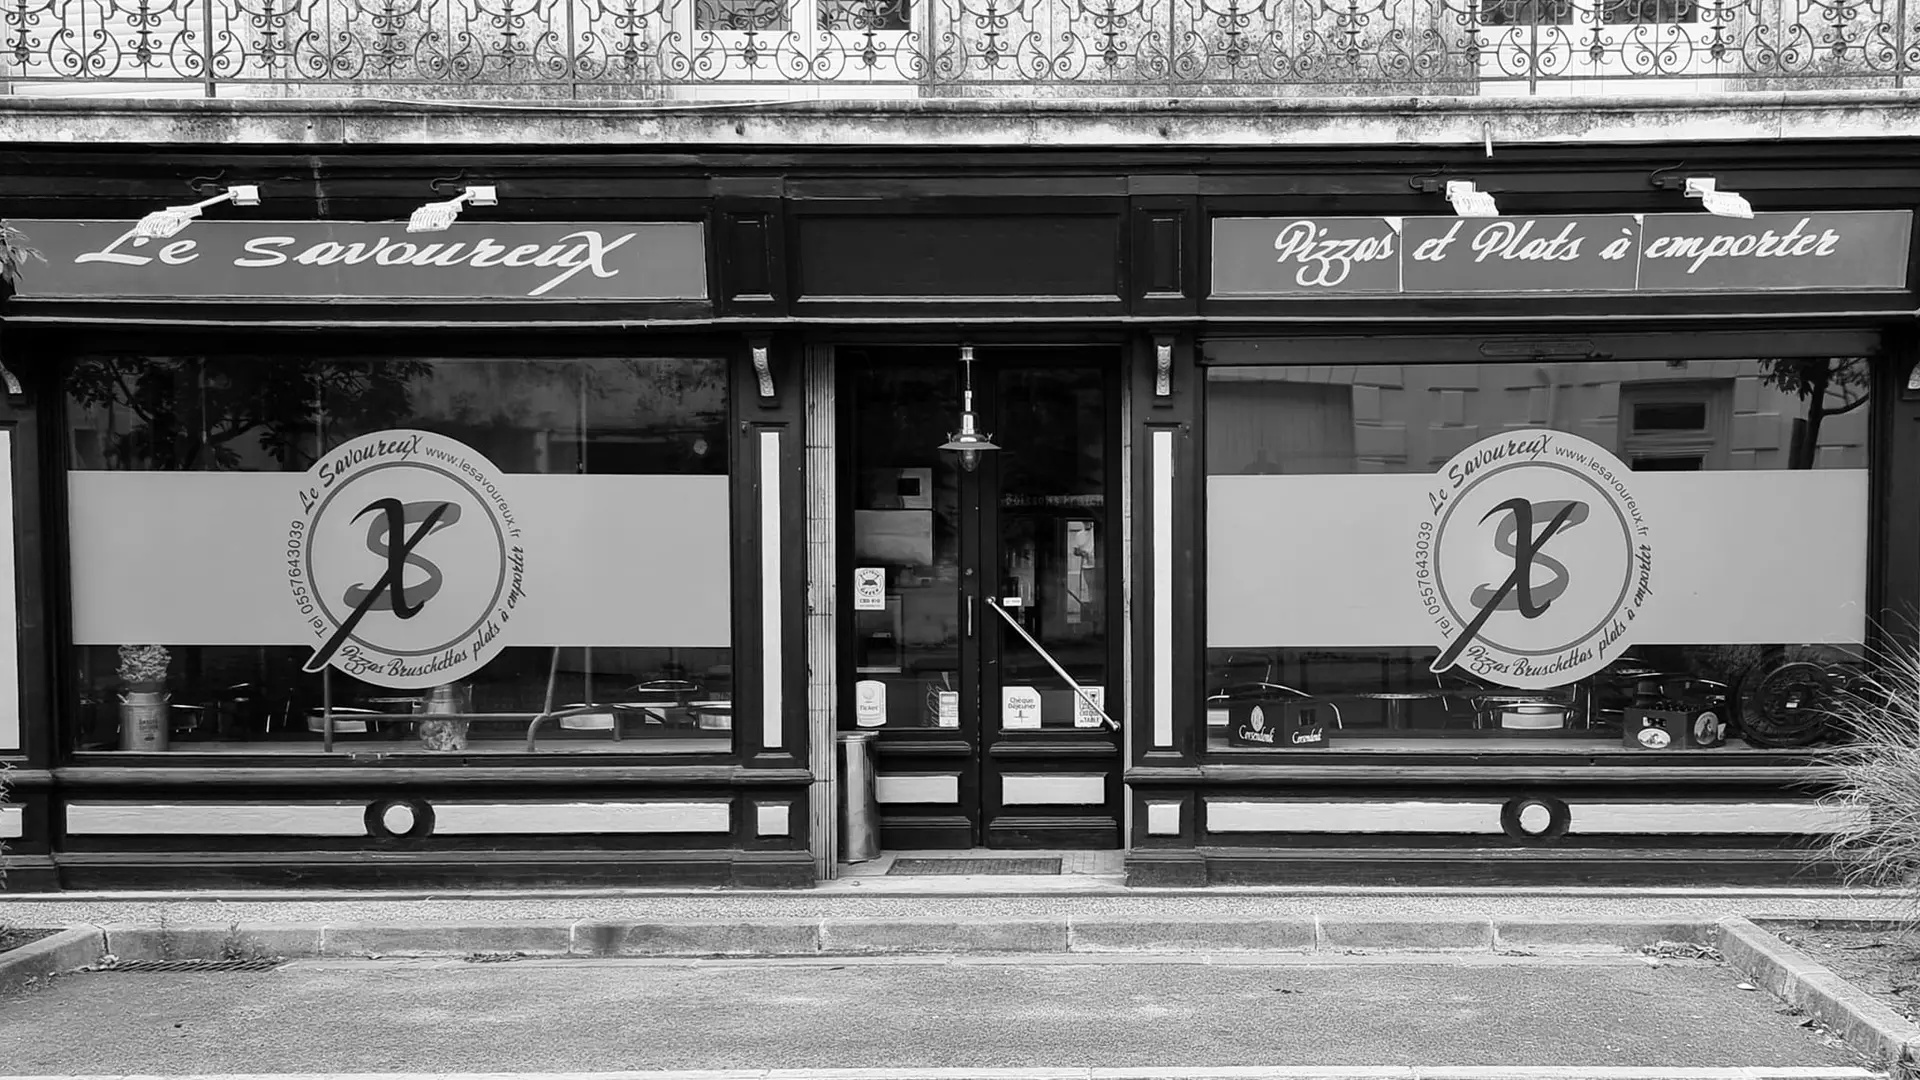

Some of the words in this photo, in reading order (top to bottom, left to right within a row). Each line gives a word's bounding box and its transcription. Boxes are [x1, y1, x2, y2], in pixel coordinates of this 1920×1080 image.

[75, 233, 200, 266] Le
[1275, 219, 1396, 287] Pizzas
[1412, 217, 1462, 261] et
[1472, 219, 1586, 263] Plats
[1598, 227, 1633, 259] à
[1644, 218, 1840, 274] emporter
[299, 488, 319, 515] Le
[425, 446, 521, 538] www.lesavoureux.fr
[1428, 488, 1448, 516] Le
[1554, 446, 1650, 537] www.lesavoureux.fr
[287, 520, 313, 615] 0557643039
[1415, 521, 1440, 615] 0557643039
[307, 615, 328, 638] Tel
[339, 645, 384, 675] Pizzas
[387, 649, 469, 677] Bruschettas
[472, 620, 501, 661] plats
[507, 545, 527, 610] emporter
[1435, 615, 1455, 638] Tel
[1466, 645, 1510, 675] Pizzas
[1512, 648, 1593, 677] Bruschettas
[1598, 619, 1627, 661] plats
[1633, 543, 1654, 608] emporter
